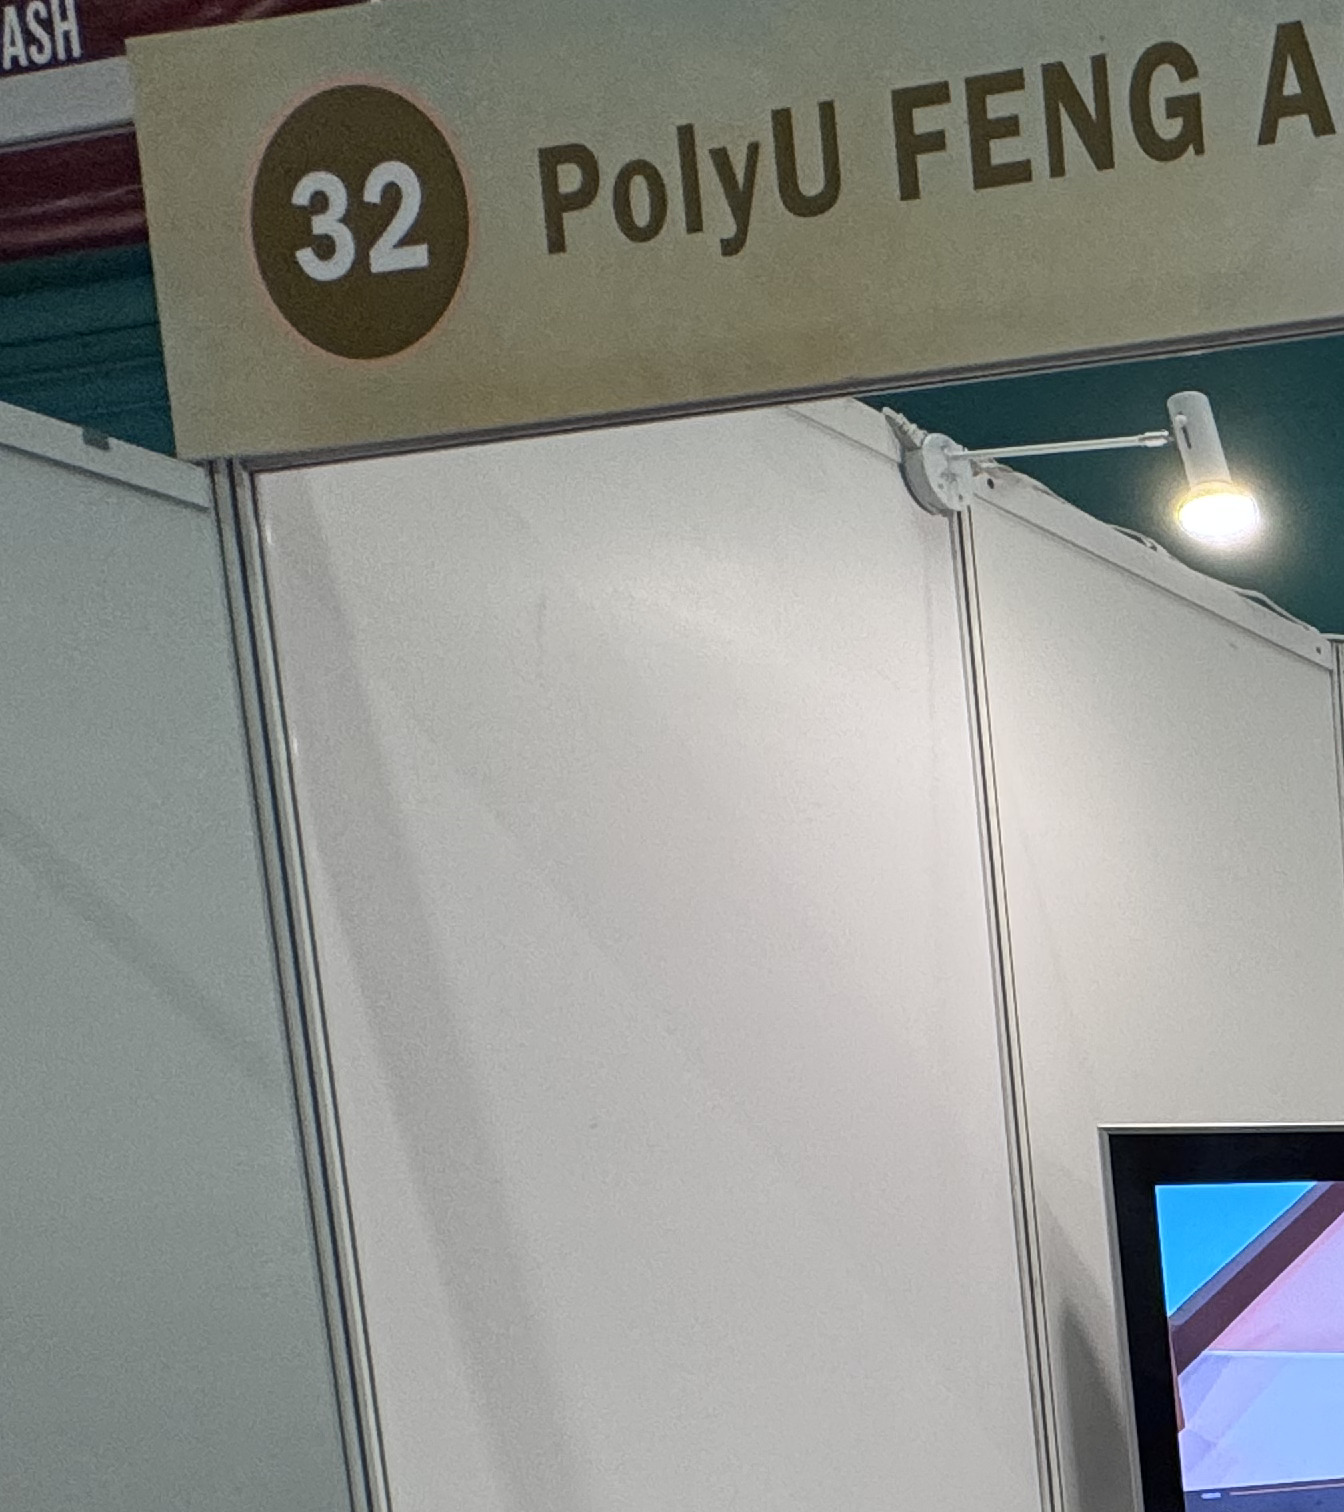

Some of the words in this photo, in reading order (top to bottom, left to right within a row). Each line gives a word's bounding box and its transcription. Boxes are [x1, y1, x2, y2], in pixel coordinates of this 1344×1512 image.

[2, 0, 81, 70] ASH
[537, 97, 843, 257] PolyU
[890, 40, 1206, 202] FENG
[290, 160, 431, 282] 32
